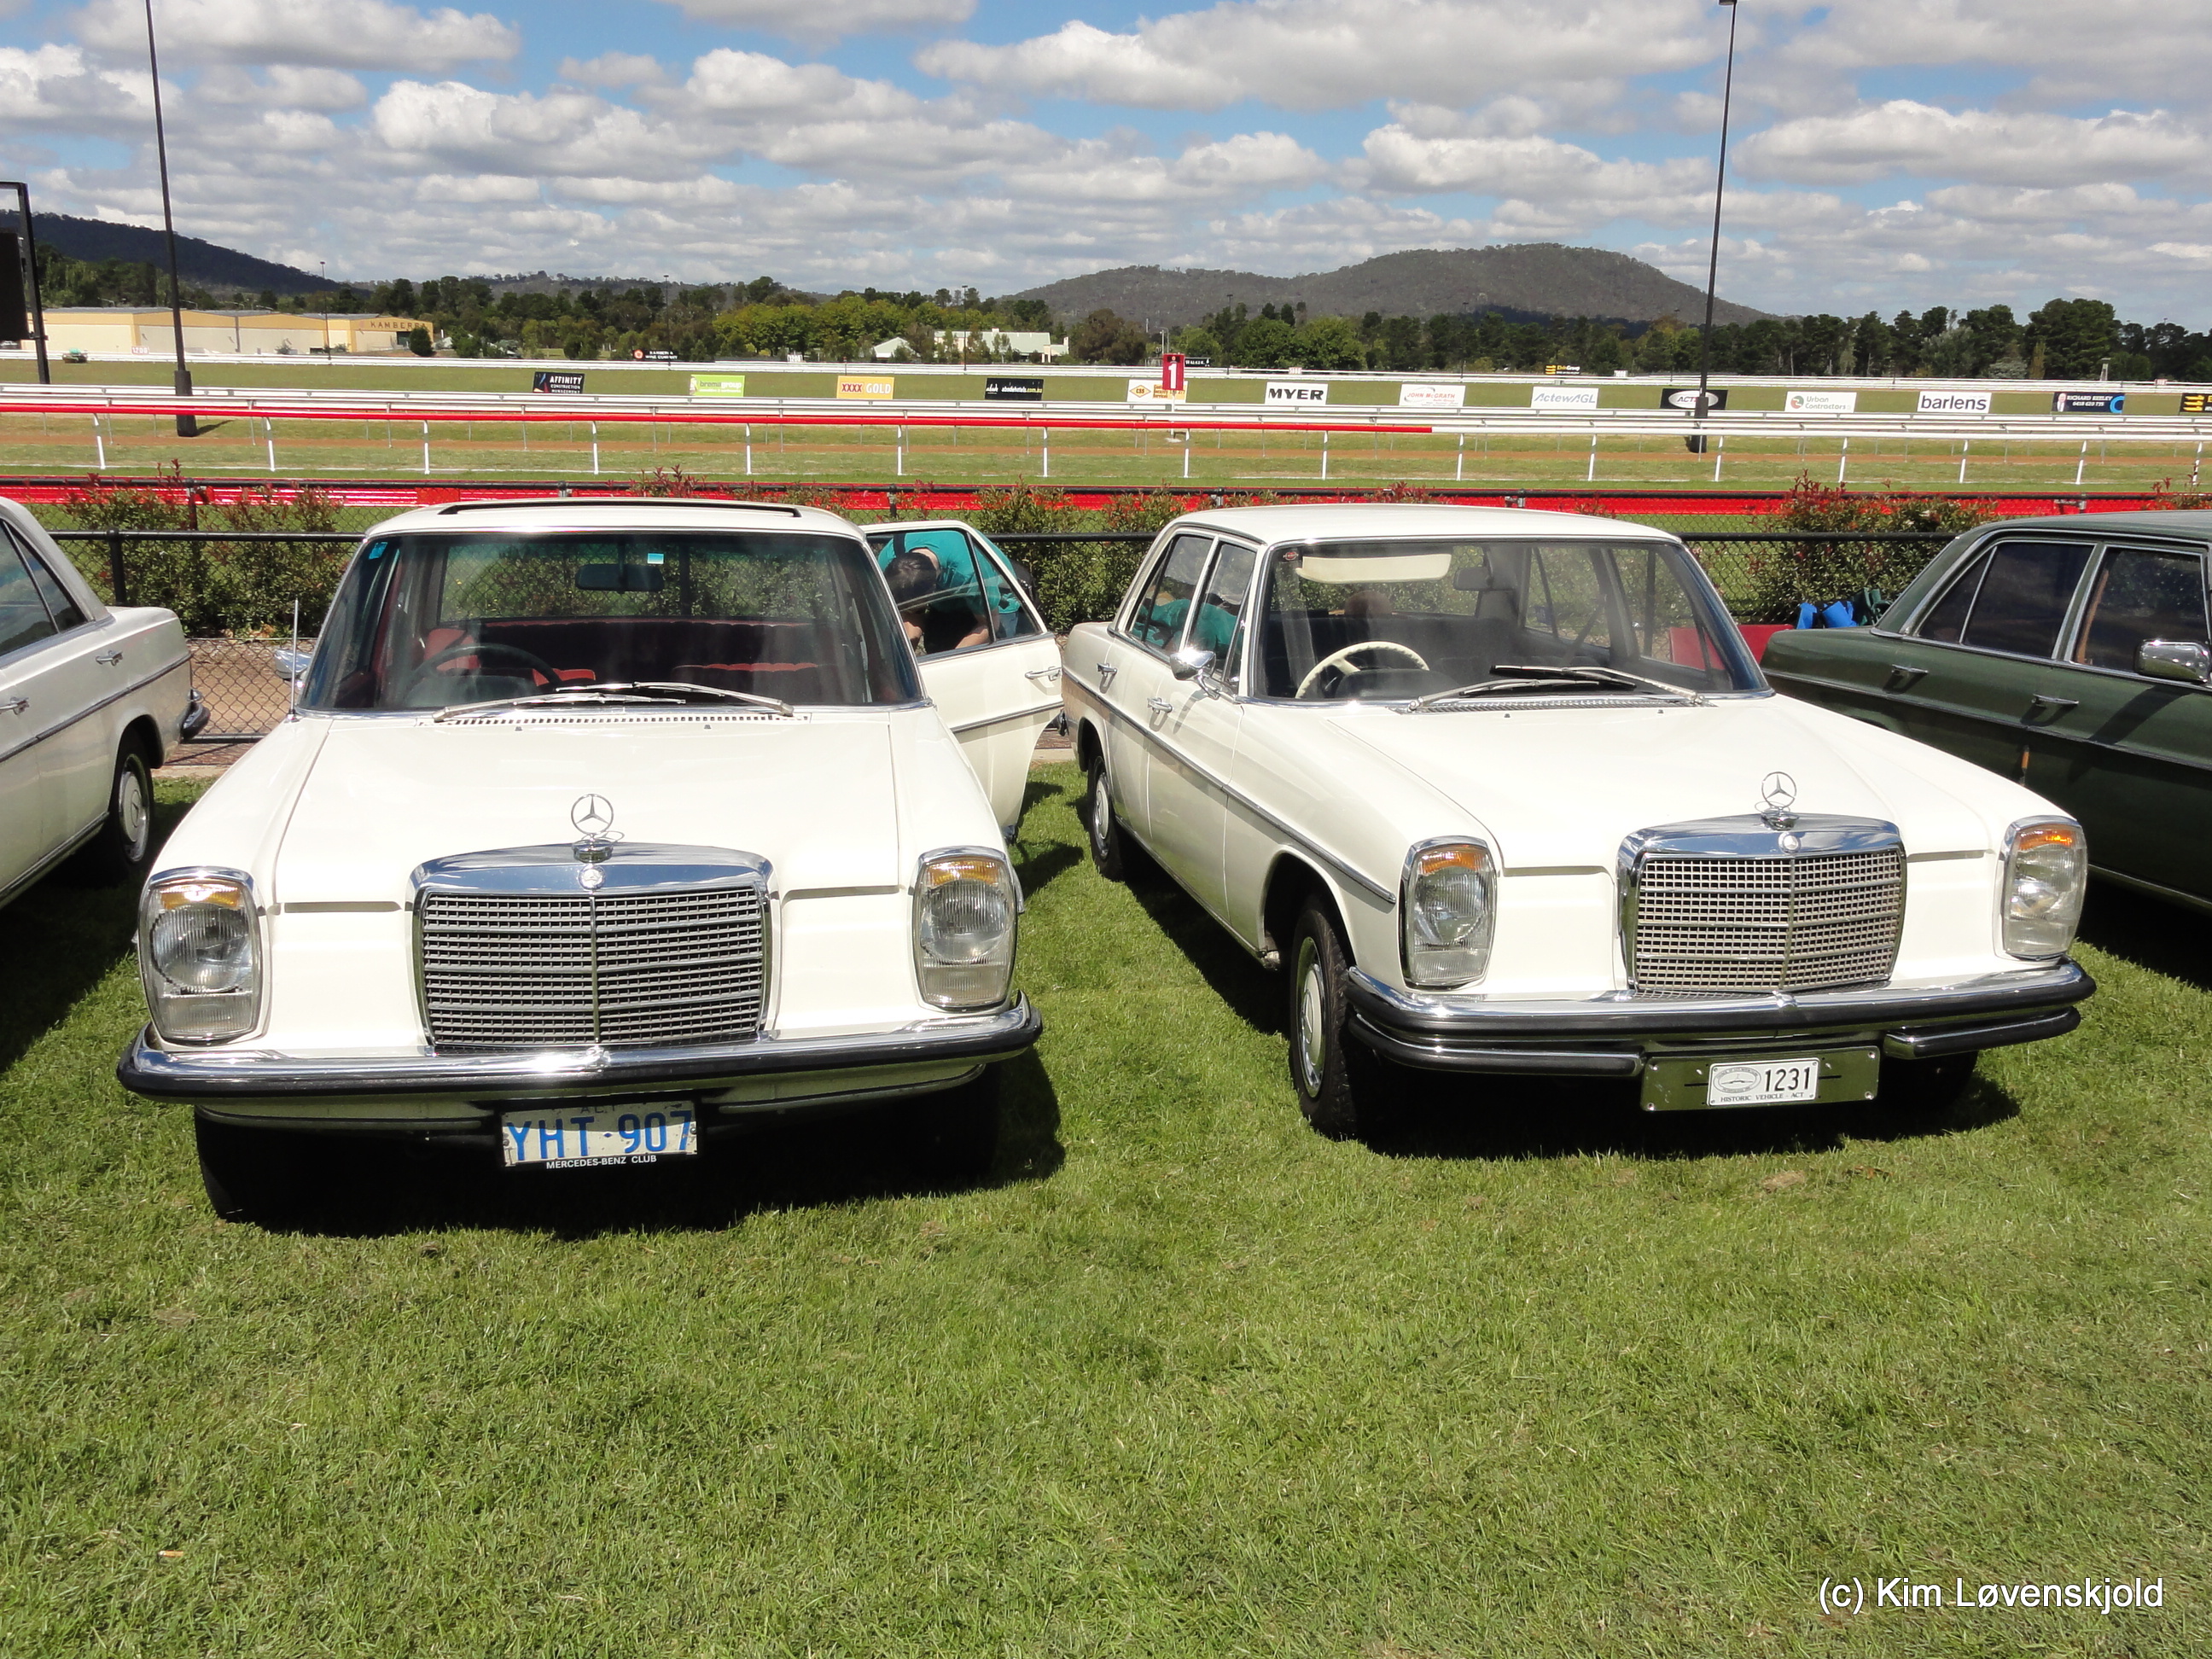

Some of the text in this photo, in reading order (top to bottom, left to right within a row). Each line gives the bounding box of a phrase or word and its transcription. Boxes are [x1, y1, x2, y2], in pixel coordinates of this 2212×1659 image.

[550, 375, 583, 384] AFFINITY
[1168, 363, 1177, 389] 1
[841, 383, 892, 393] XXXX GOLD
[1268, 388, 1324, 400] MYER
[1534, 393, 1596, 404] ActewAGL
[1921, 395, 1988, 410] barlens
[1765, 1067, 1810, 1092] 1231
[546, 1155, 657, 1170] MERCEDES-BENZ CLUB
